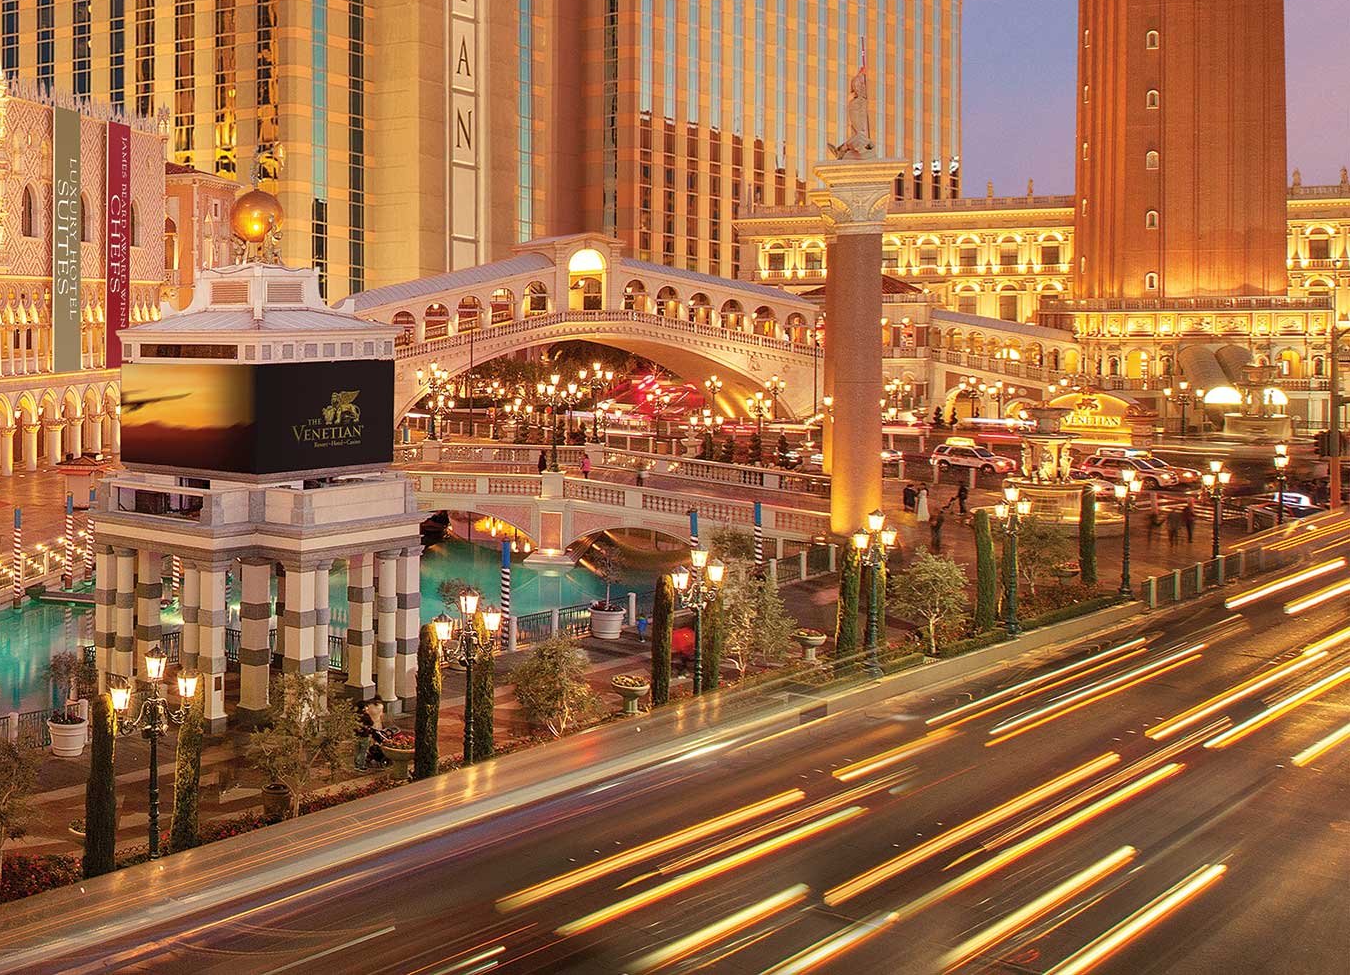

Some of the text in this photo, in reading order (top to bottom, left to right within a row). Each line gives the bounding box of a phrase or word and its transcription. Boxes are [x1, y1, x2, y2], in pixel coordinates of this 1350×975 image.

[120, 136, 128, 179] JAMES
[120, 183, 128, 229] BEARD
[57, 178, 69, 296] SUITES
[69, 157, 78, 321] LUXURY HOTEL
[110, 194, 122, 293] CHEFS
[291, 424, 363, 443] VENETIAN
[1060, 414, 1122, 426] VENETIAN
